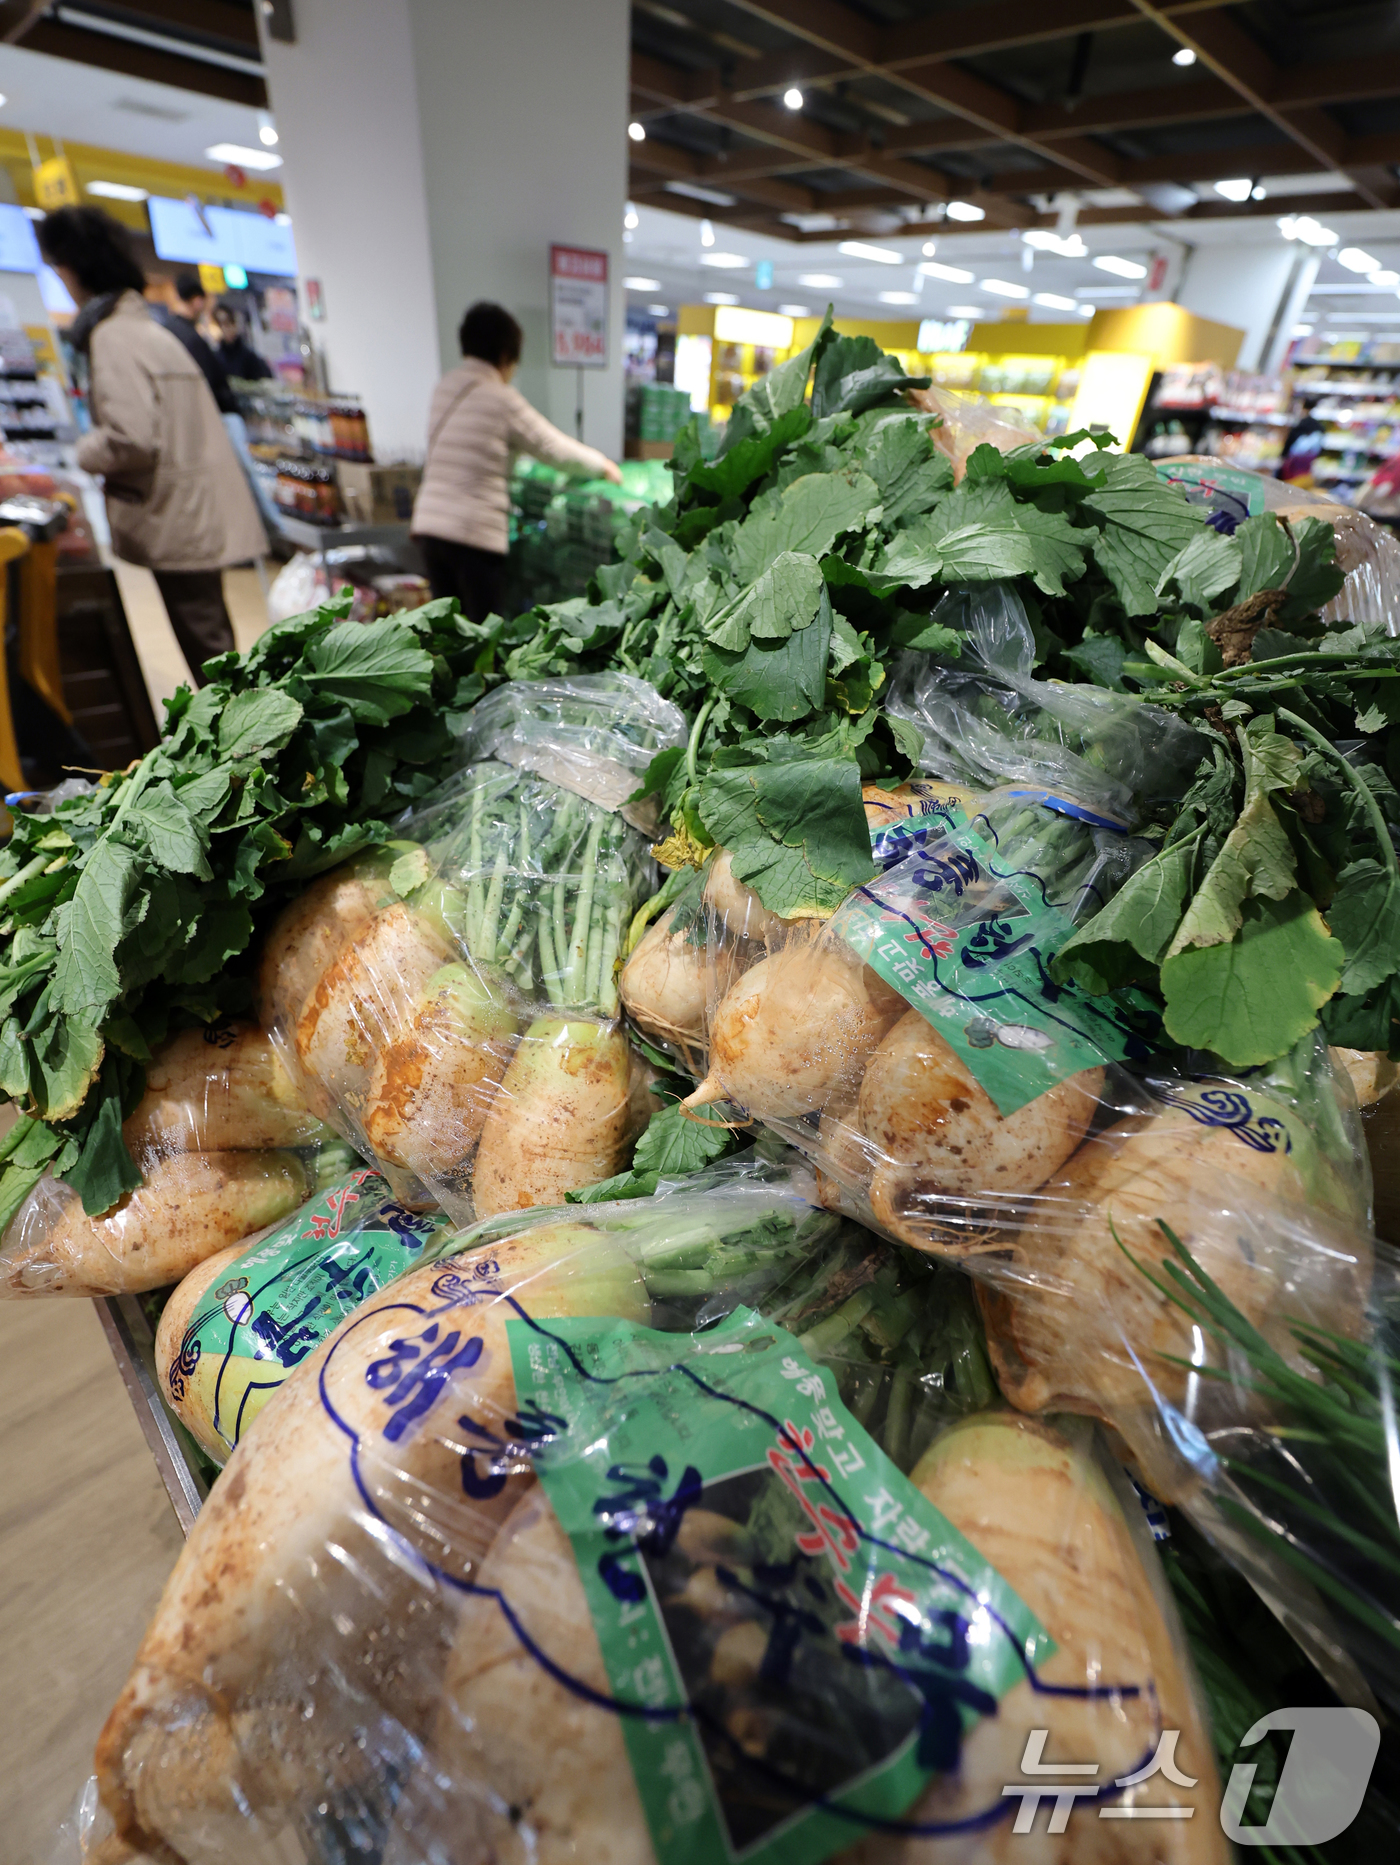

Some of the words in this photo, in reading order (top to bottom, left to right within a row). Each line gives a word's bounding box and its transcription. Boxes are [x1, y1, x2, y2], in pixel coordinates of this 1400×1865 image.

[877, 937, 953, 1019] 해풍맞고
[286, 1290, 308, 1313] 작지만
[780, 1355, 865, 1480] 해풍맞고
[864, 1486, 932, 1562] 자란
